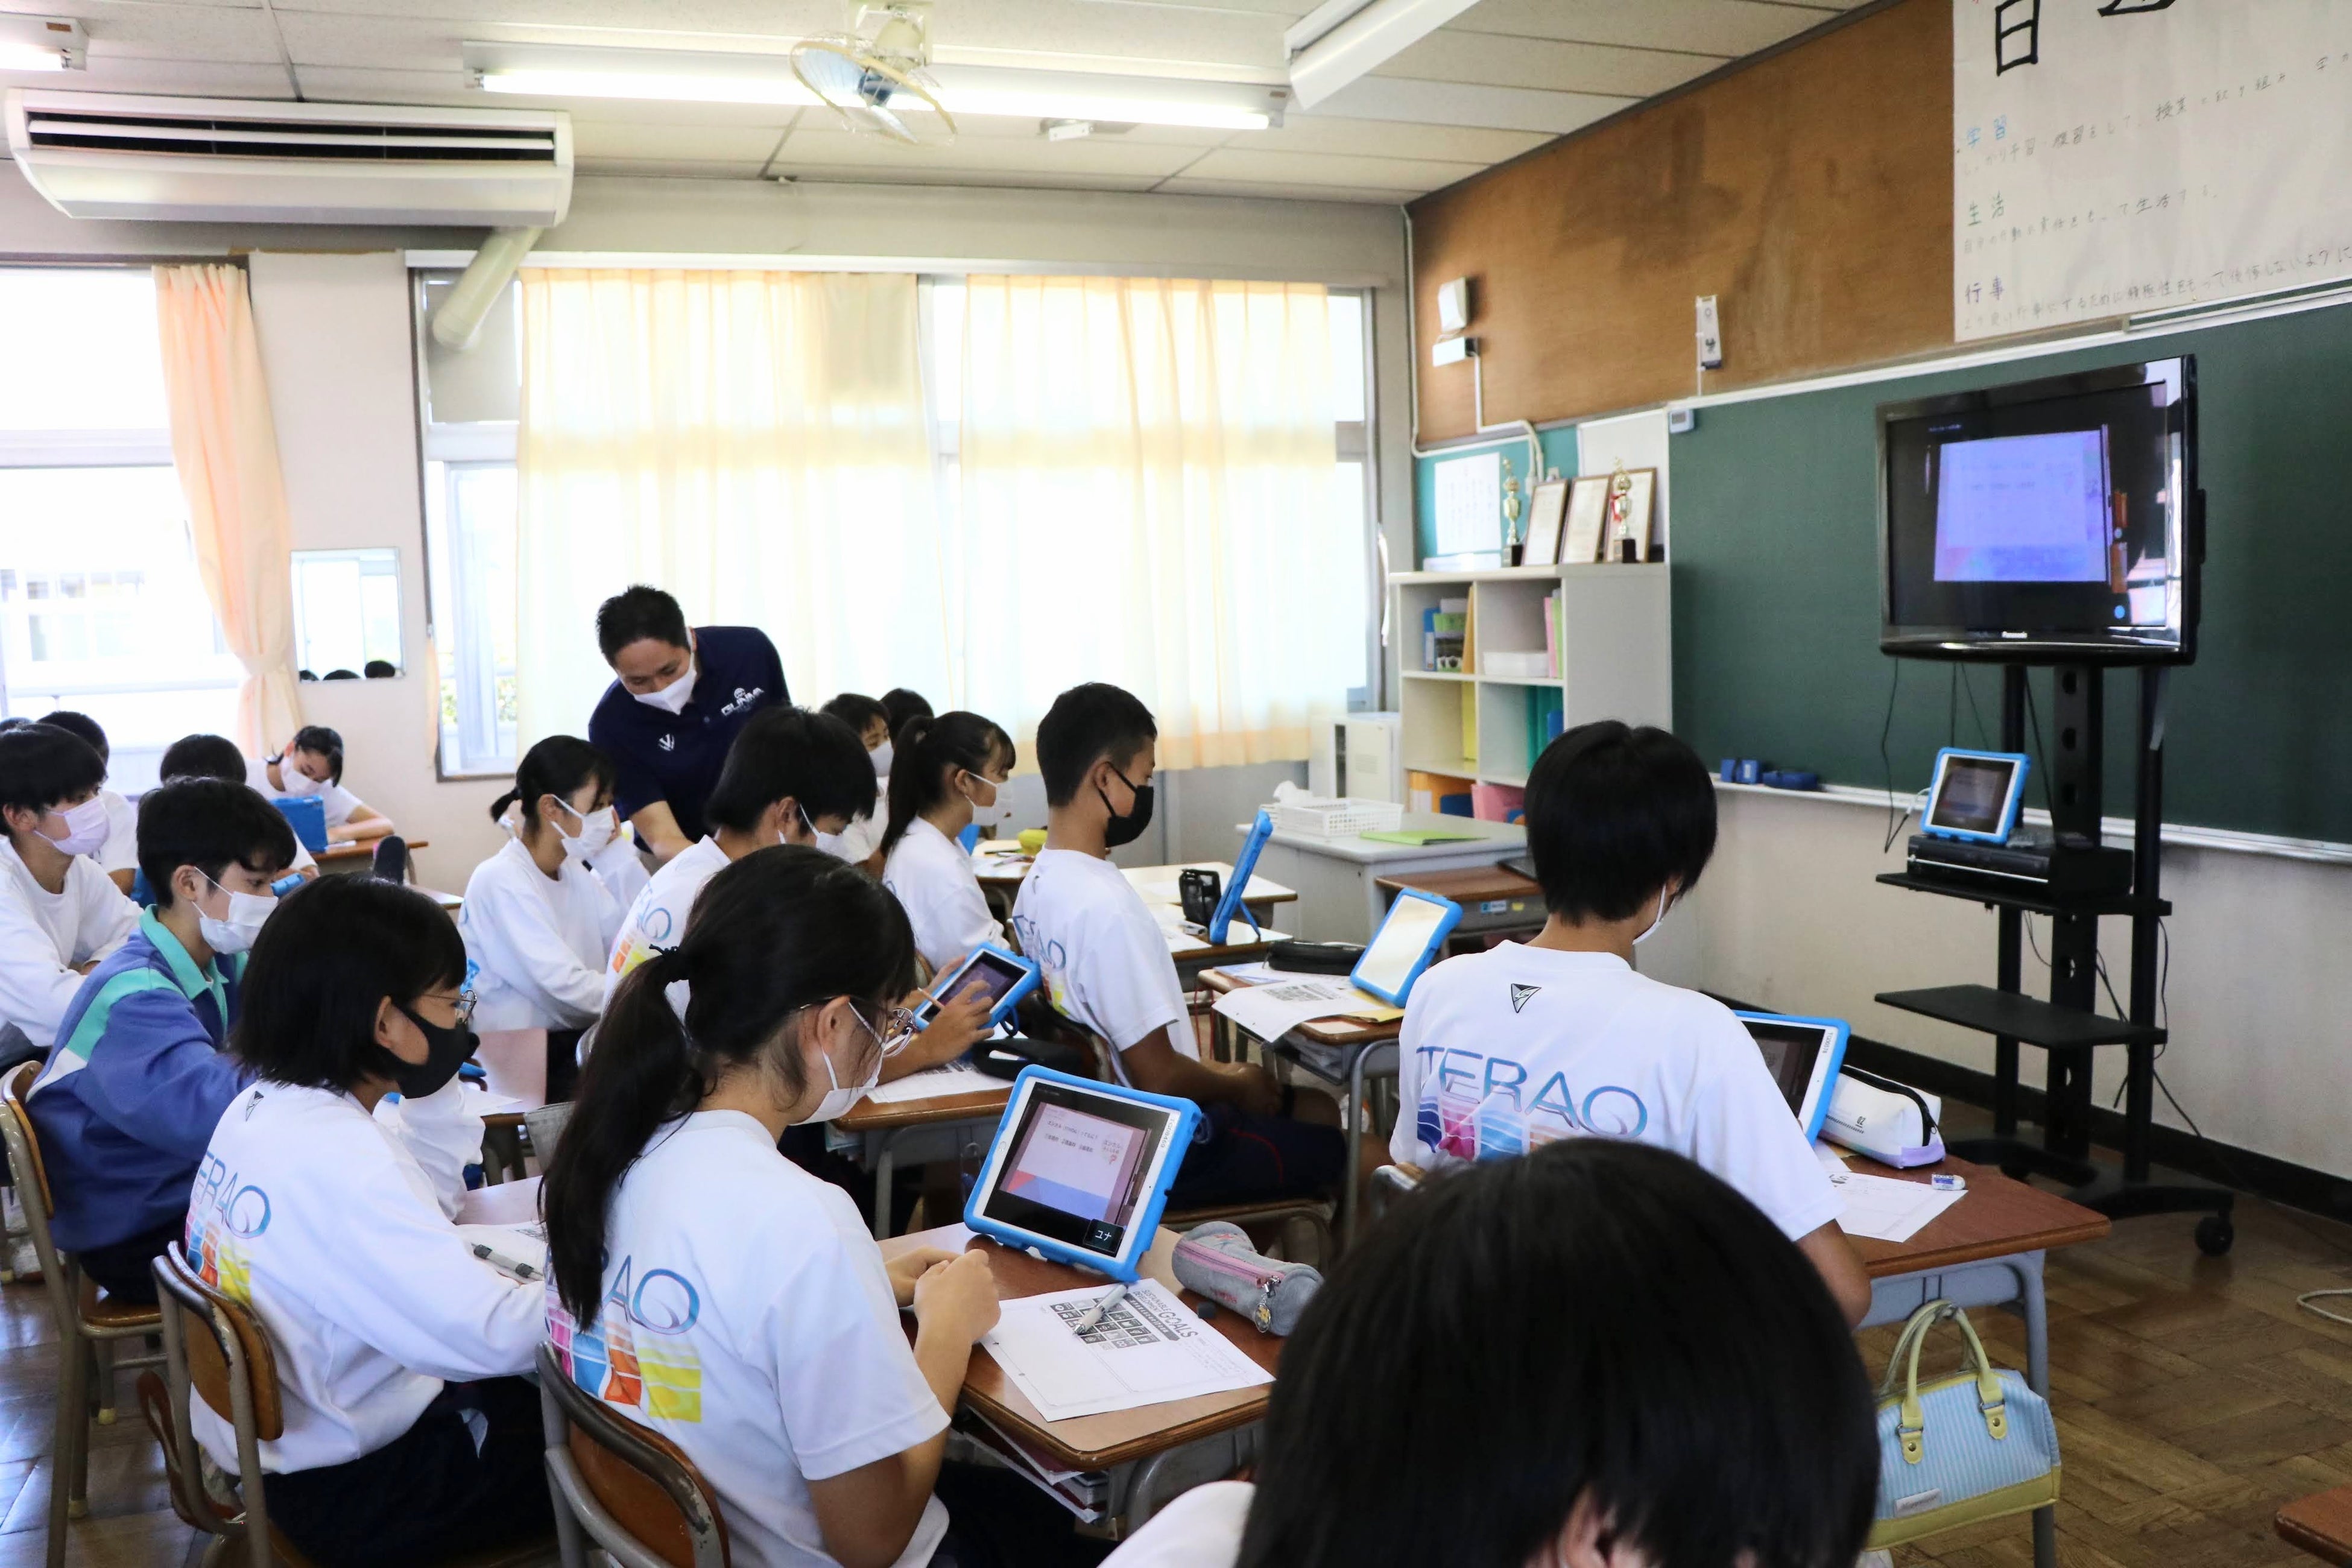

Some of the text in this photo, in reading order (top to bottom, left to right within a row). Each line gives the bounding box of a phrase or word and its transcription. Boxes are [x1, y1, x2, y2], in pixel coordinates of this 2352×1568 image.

[1967, 190, 2005, 227] 生活
[1964, 275, 2005, 305] 行事
[1415, 1045, 1648, 1139] TERAO
[1095, 1230, 1112, 1241] ユナ
[1159, 1311, 1198, 1338] GOALS
